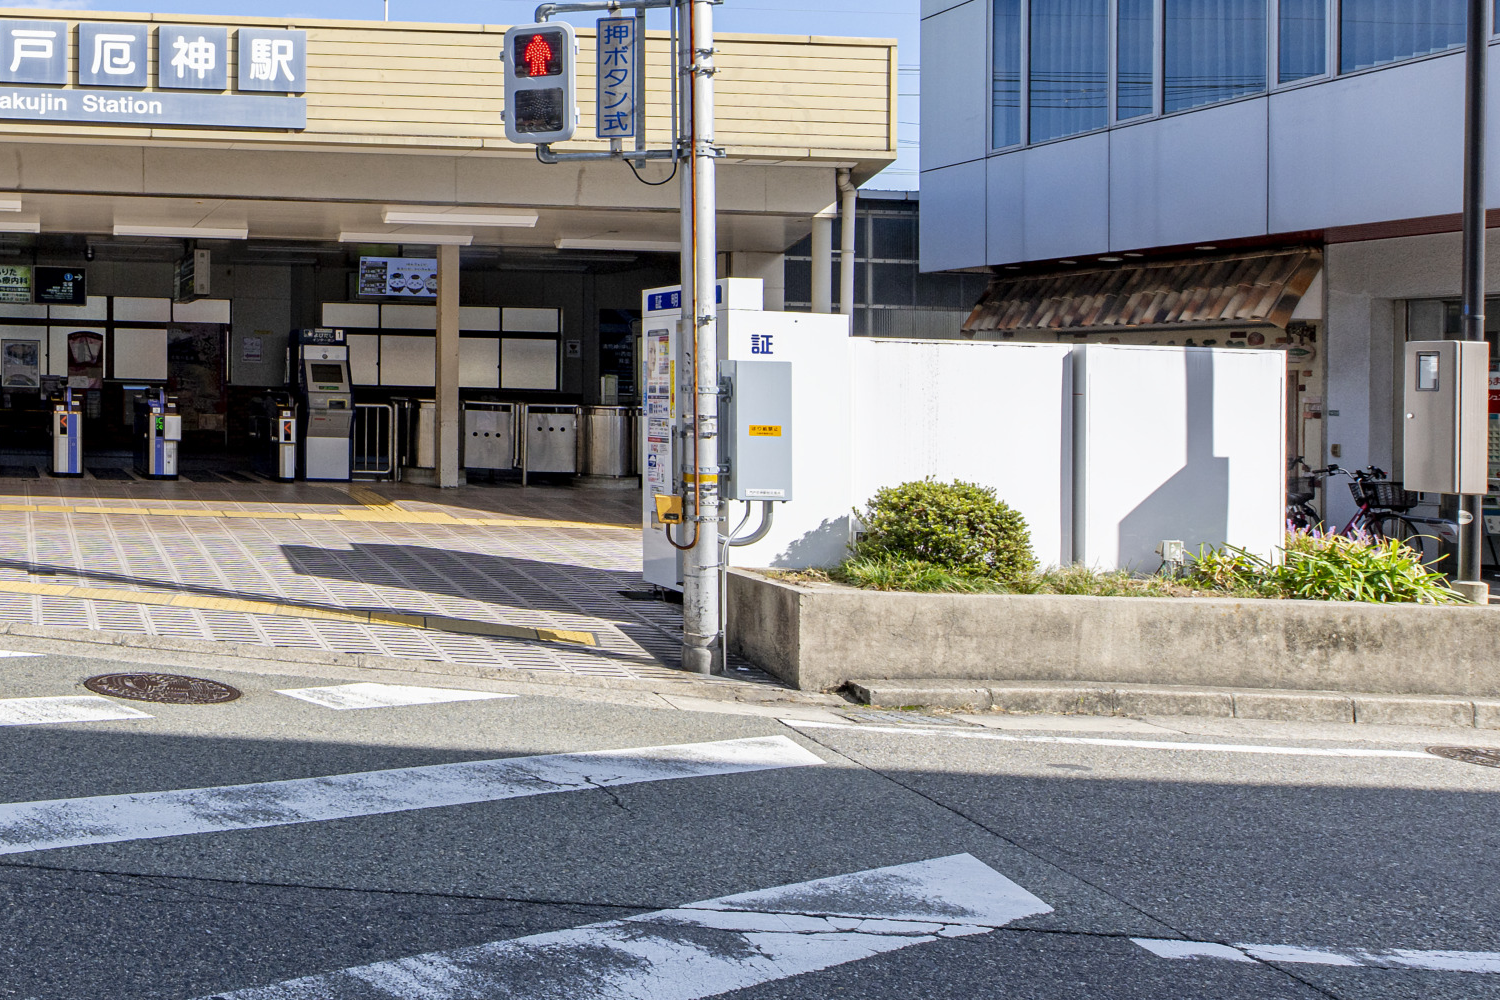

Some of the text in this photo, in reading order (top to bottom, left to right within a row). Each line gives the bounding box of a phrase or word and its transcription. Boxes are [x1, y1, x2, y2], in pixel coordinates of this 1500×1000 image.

[603, 24, 629, 131] 押ボタン式
[82, 94, 163, 115] Station
[750, 334, 774, 355] 証
